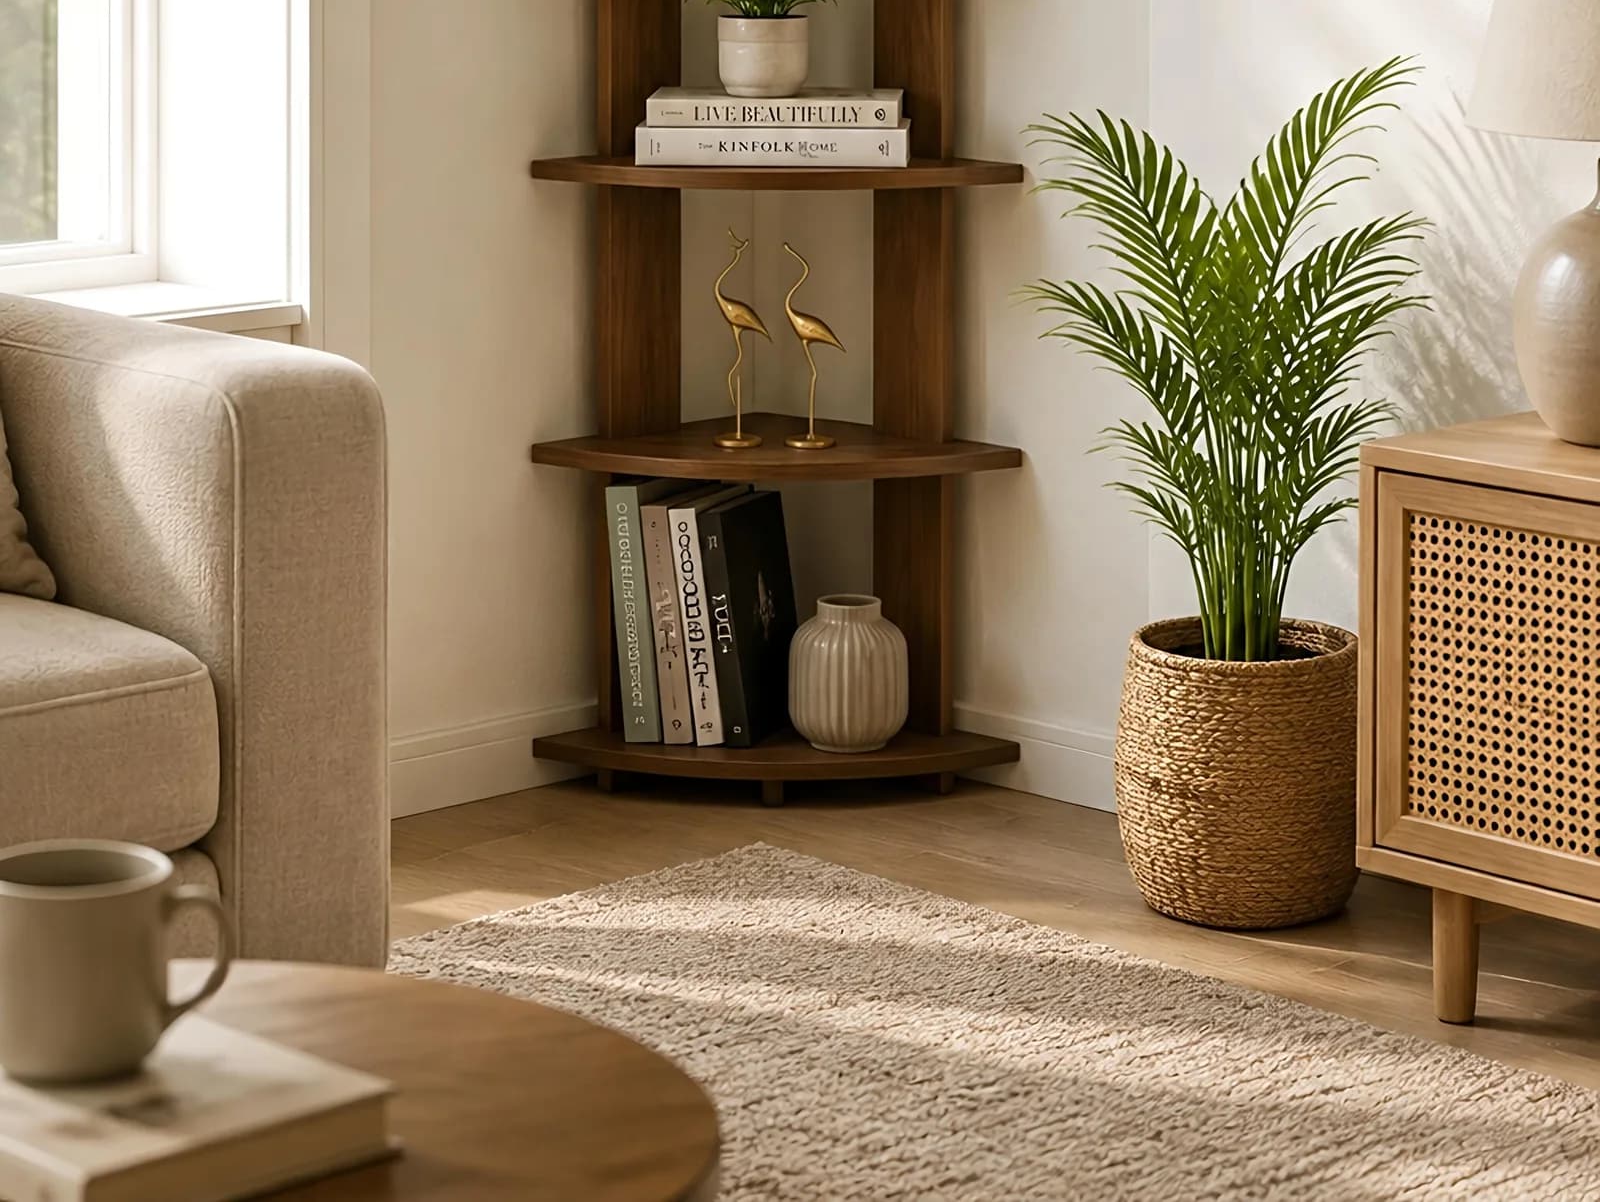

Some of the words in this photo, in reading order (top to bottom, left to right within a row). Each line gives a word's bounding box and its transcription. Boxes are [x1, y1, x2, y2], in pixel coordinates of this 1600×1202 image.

[694, 105, 737, 122] LIVE
[742, 105, 862, 123] BEAUTIFULLY
[718, 140, 795, 153] KINFOLK
